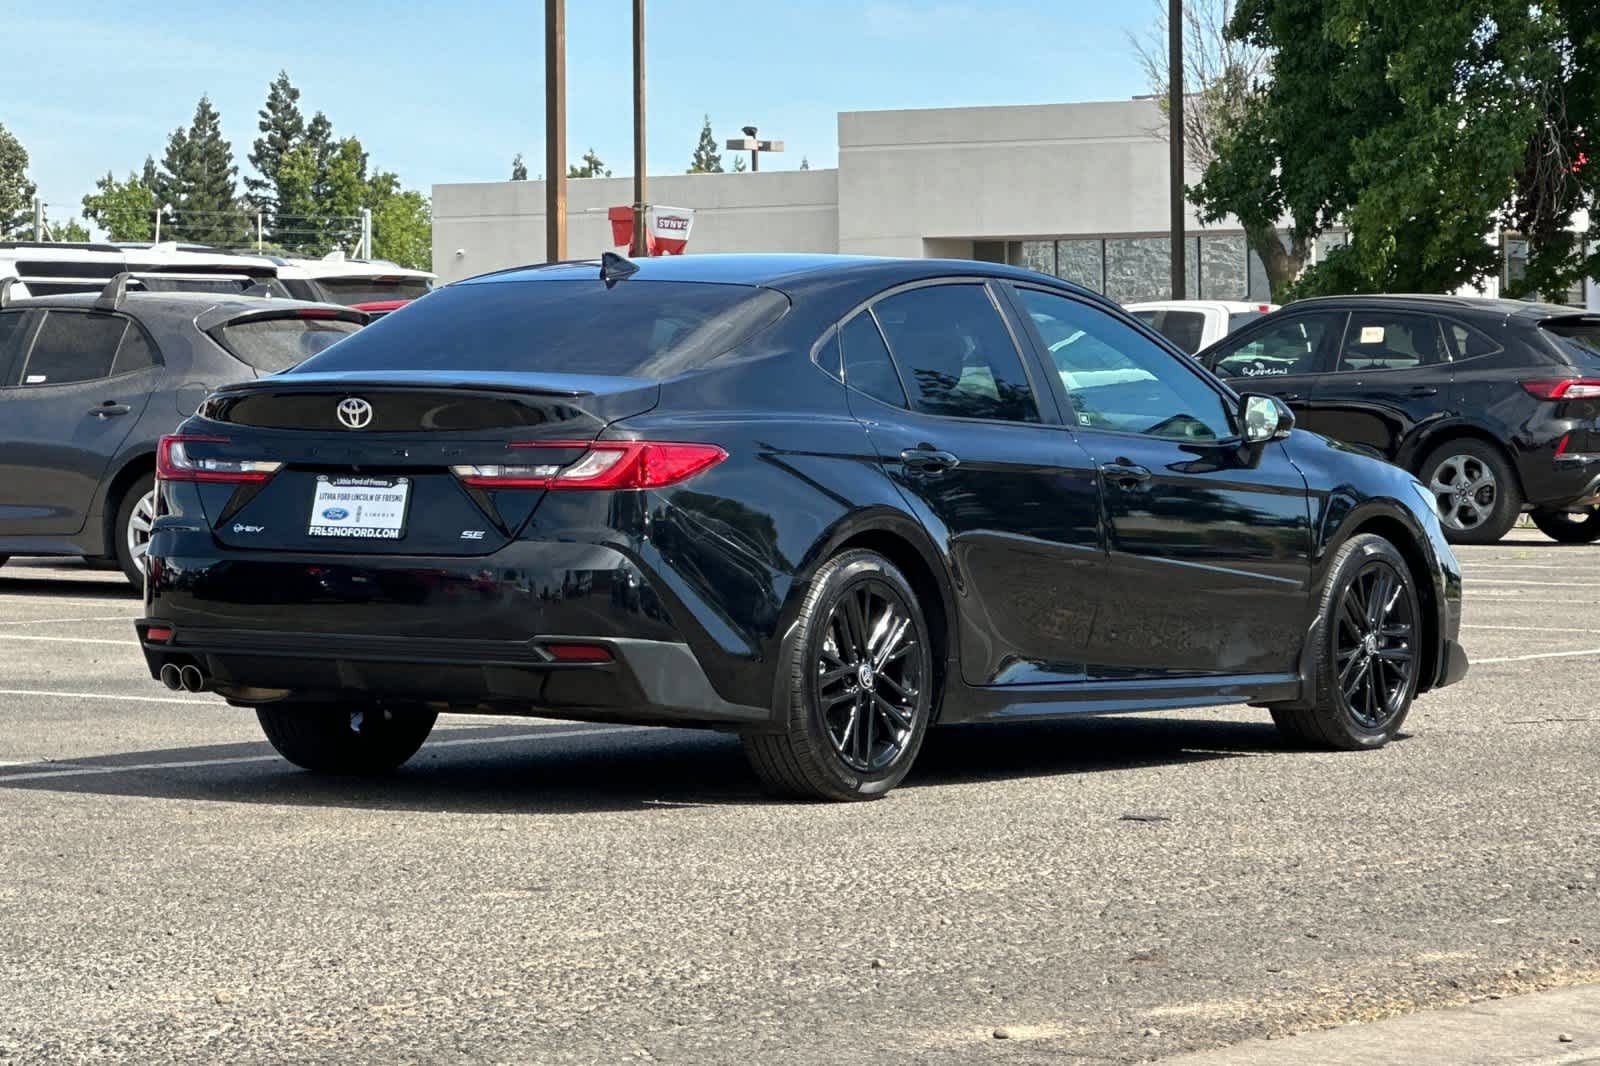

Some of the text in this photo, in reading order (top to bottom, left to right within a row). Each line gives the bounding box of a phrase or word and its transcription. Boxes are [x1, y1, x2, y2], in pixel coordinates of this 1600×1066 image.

[351, 478, 364, 486] Ford
[319, 492, 403, 502] LITHIA FORD LINCOLN OF FRESNO
[309, 526, 400, 538] FRESNOFORD.COM
[460, 530, 485, 539] SE
